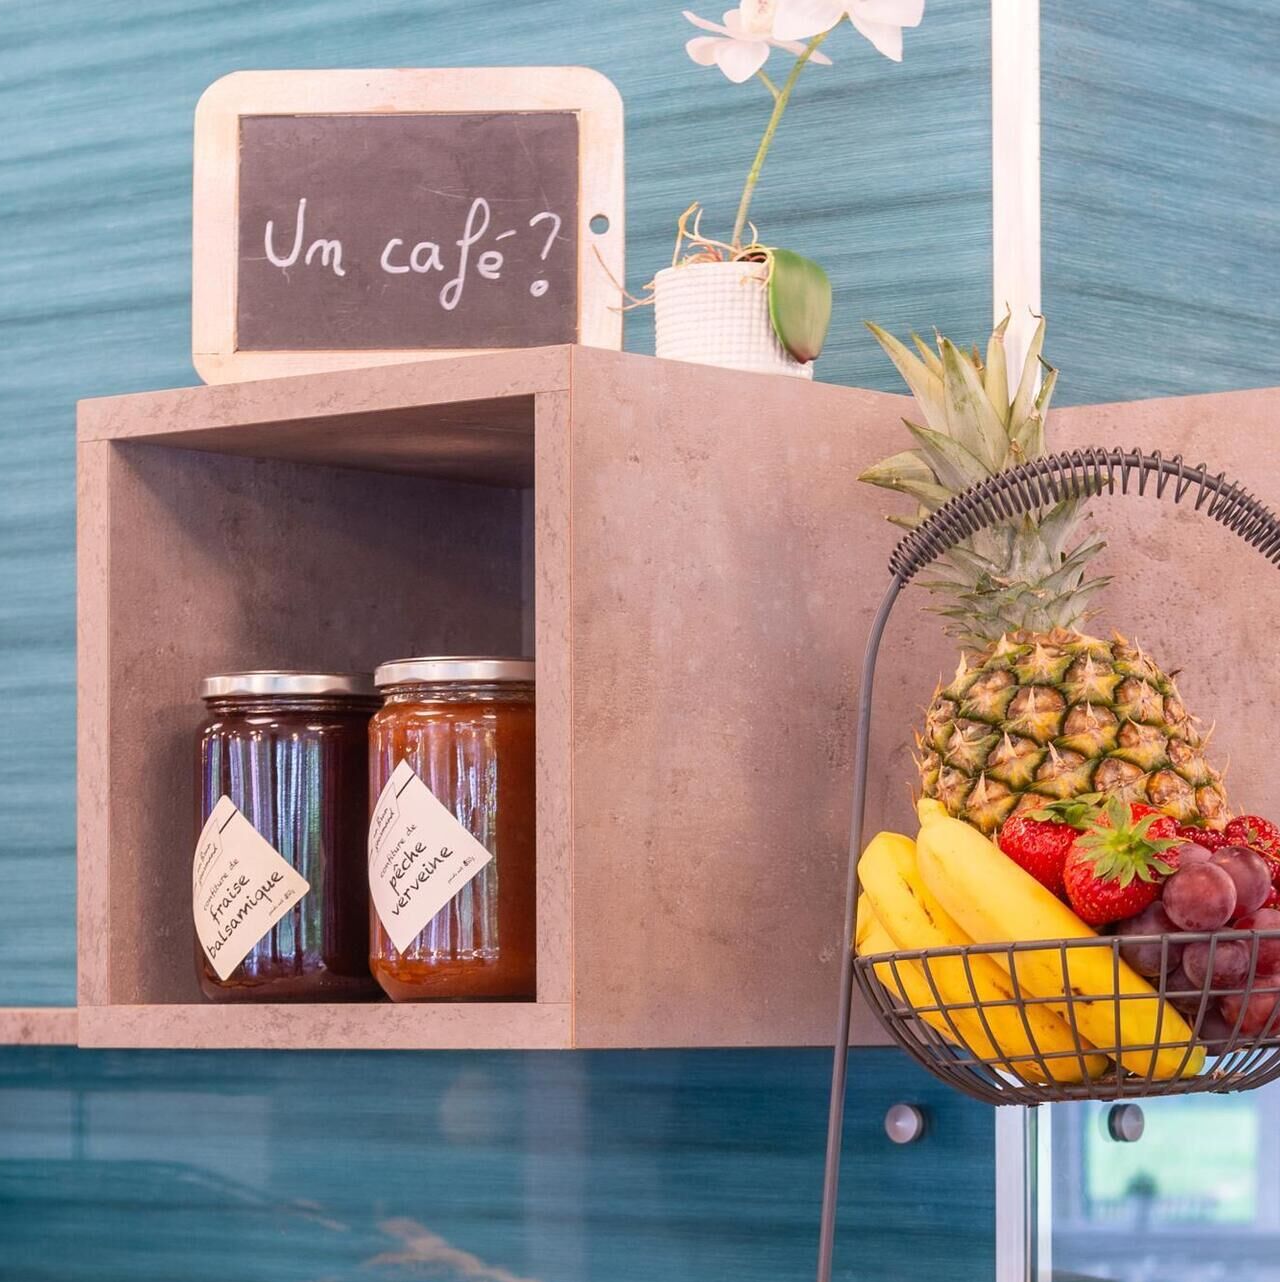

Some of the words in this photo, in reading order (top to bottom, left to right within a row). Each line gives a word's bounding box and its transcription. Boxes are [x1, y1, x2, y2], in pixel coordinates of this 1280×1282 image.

[264, 197, 346, 277] Un
[209, 873, 251, 926] fraise
[388, 840, 428, 897] pêche
[391, 845, 454, 916] verveine
[206, 870, 284, 960] balsamique
